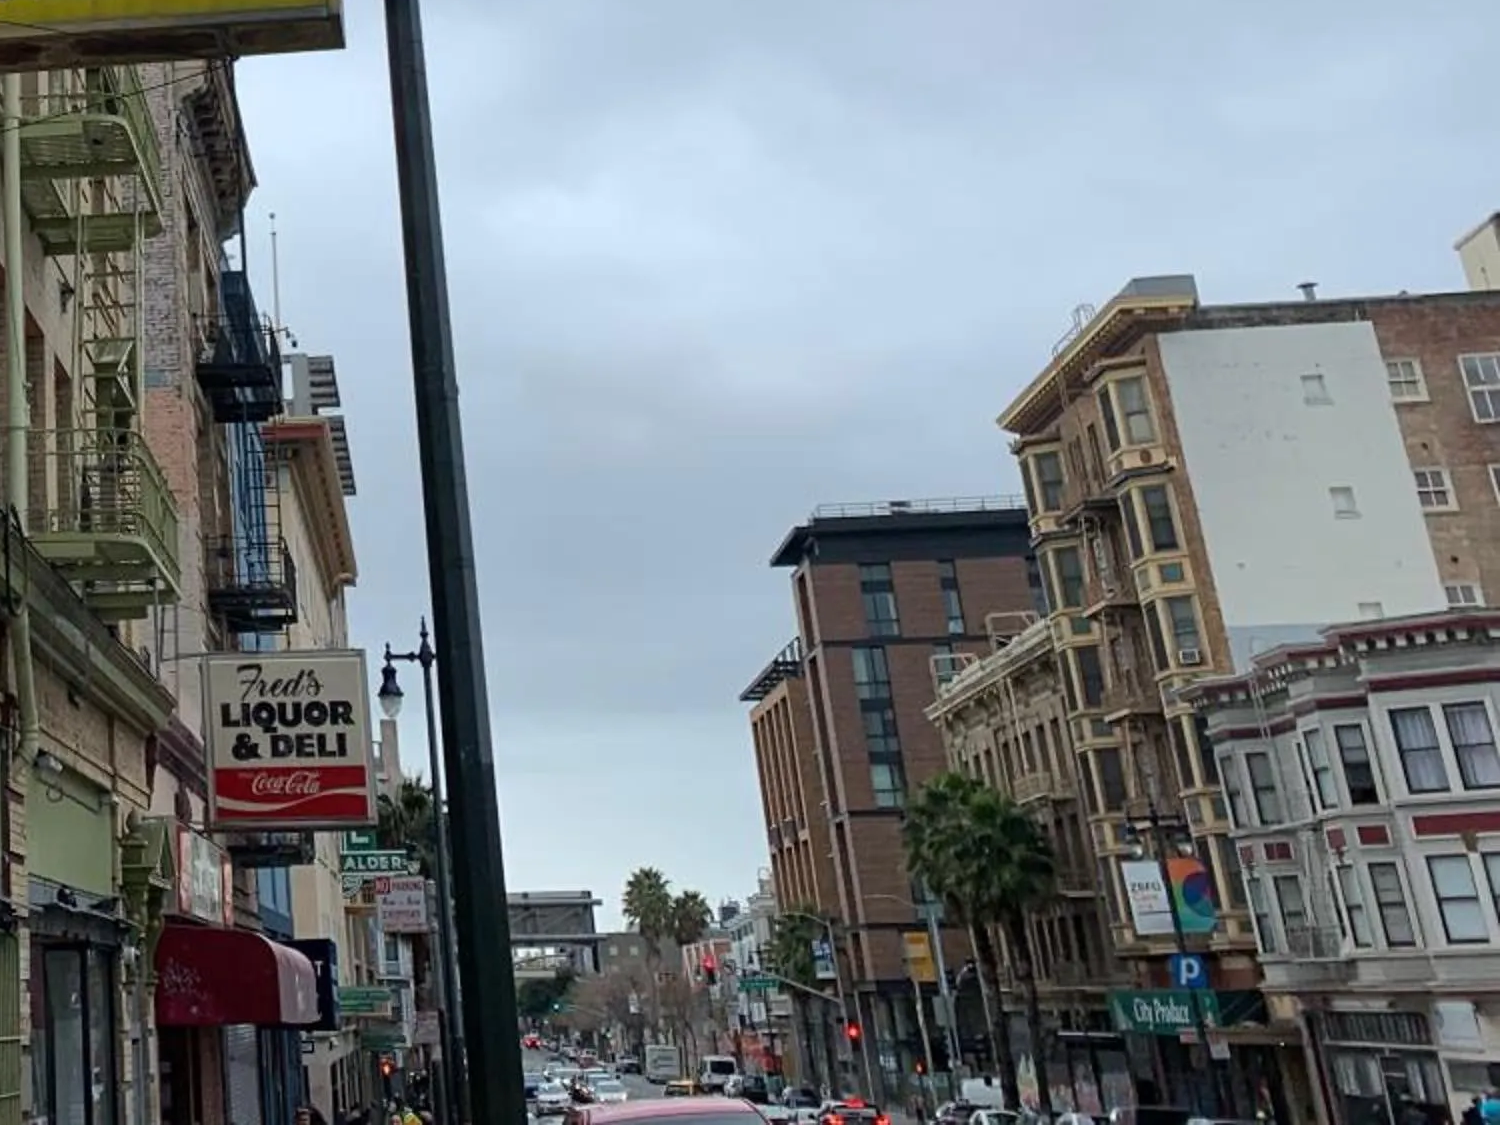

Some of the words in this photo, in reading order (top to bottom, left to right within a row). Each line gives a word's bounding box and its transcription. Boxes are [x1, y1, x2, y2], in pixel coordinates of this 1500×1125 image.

[237, 663, 324, 702] Fred's
[220, 701, 355, 733] LIQUOR
[232, 733, 262, 761] &
[270, 733, 347, 758] DELI
[343, 856, 401, 870] ALDER
[1180, 956, 1200, 985] P
[1133, 996, 1153, 1030] City
